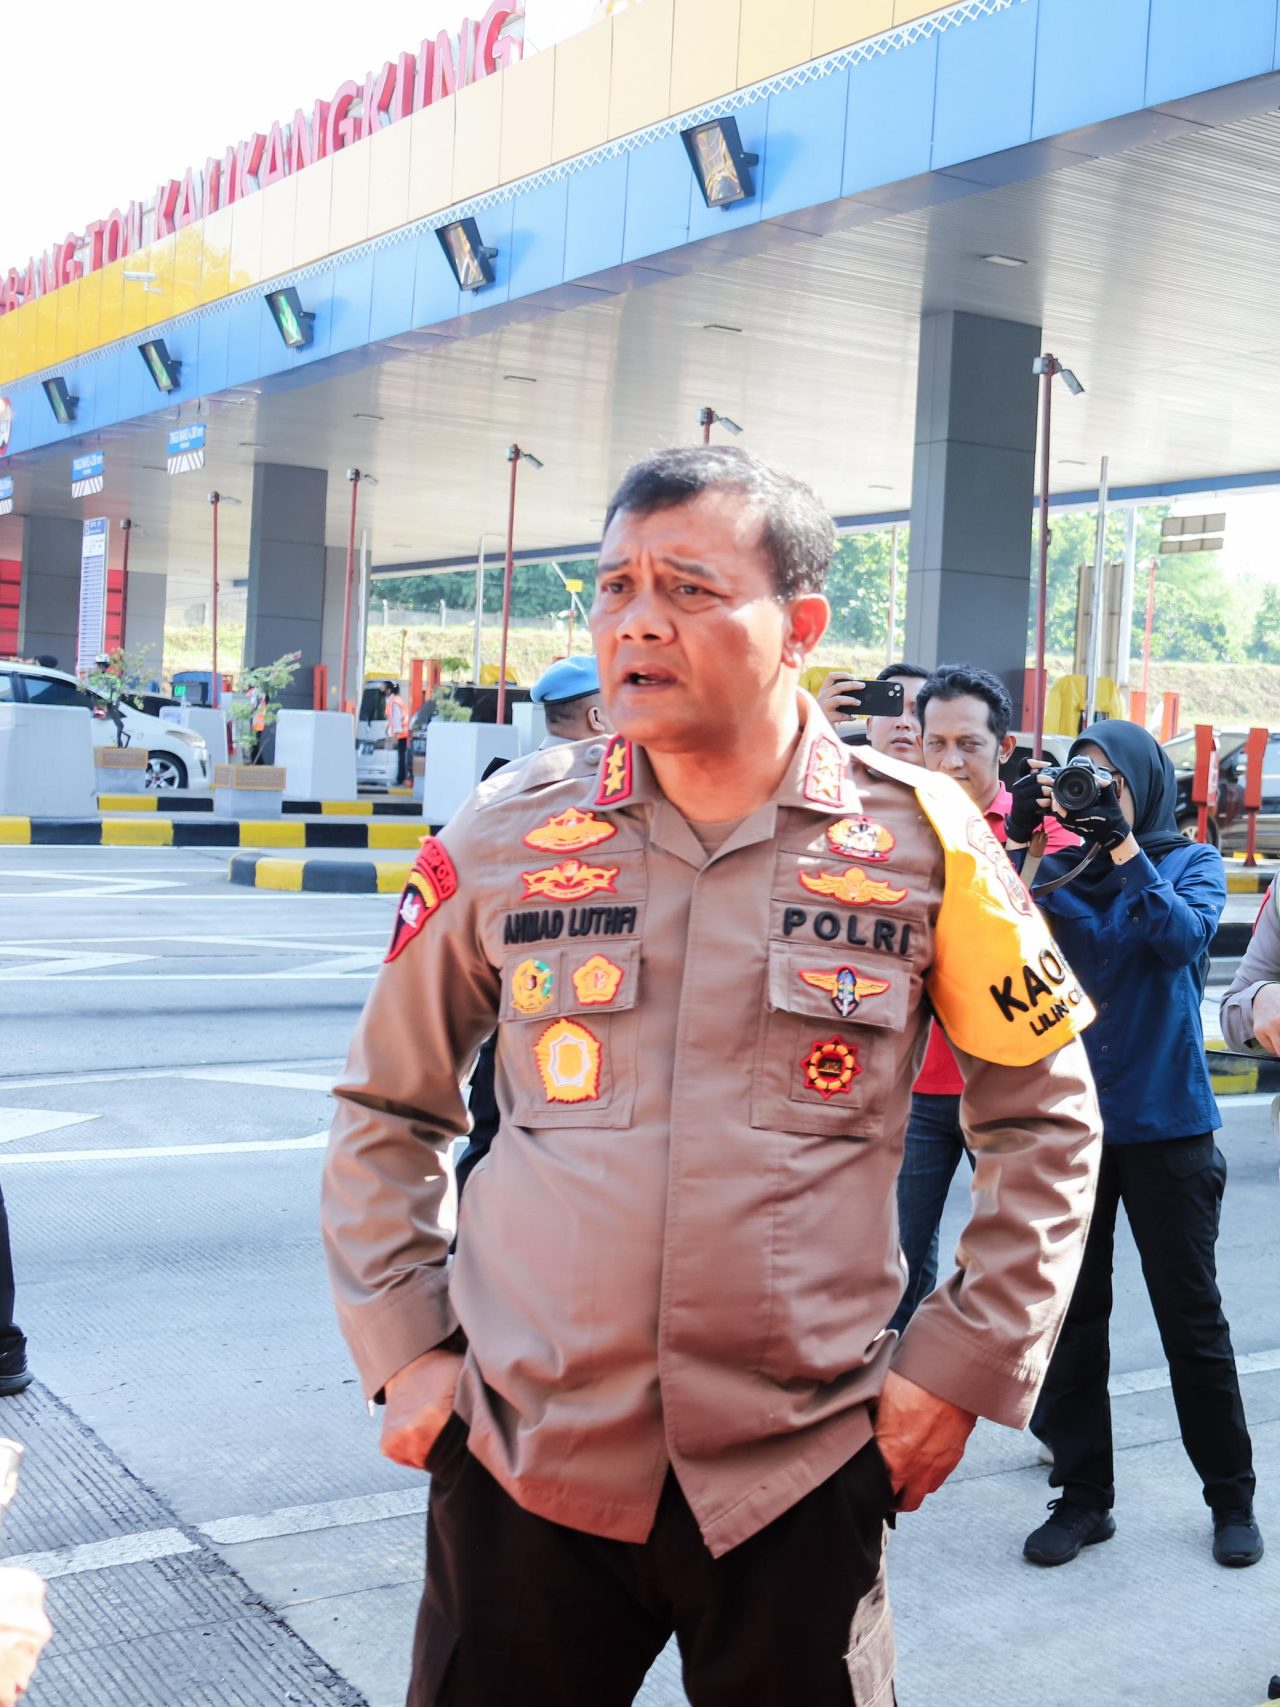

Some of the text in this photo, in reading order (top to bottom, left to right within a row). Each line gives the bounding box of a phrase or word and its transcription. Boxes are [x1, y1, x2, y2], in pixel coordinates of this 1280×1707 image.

[504, 906, 637, 945] AHMAD LUTHFI
[783, 907, 912, 955] POLRI
[989, 938, 1071, 1022] KAO
